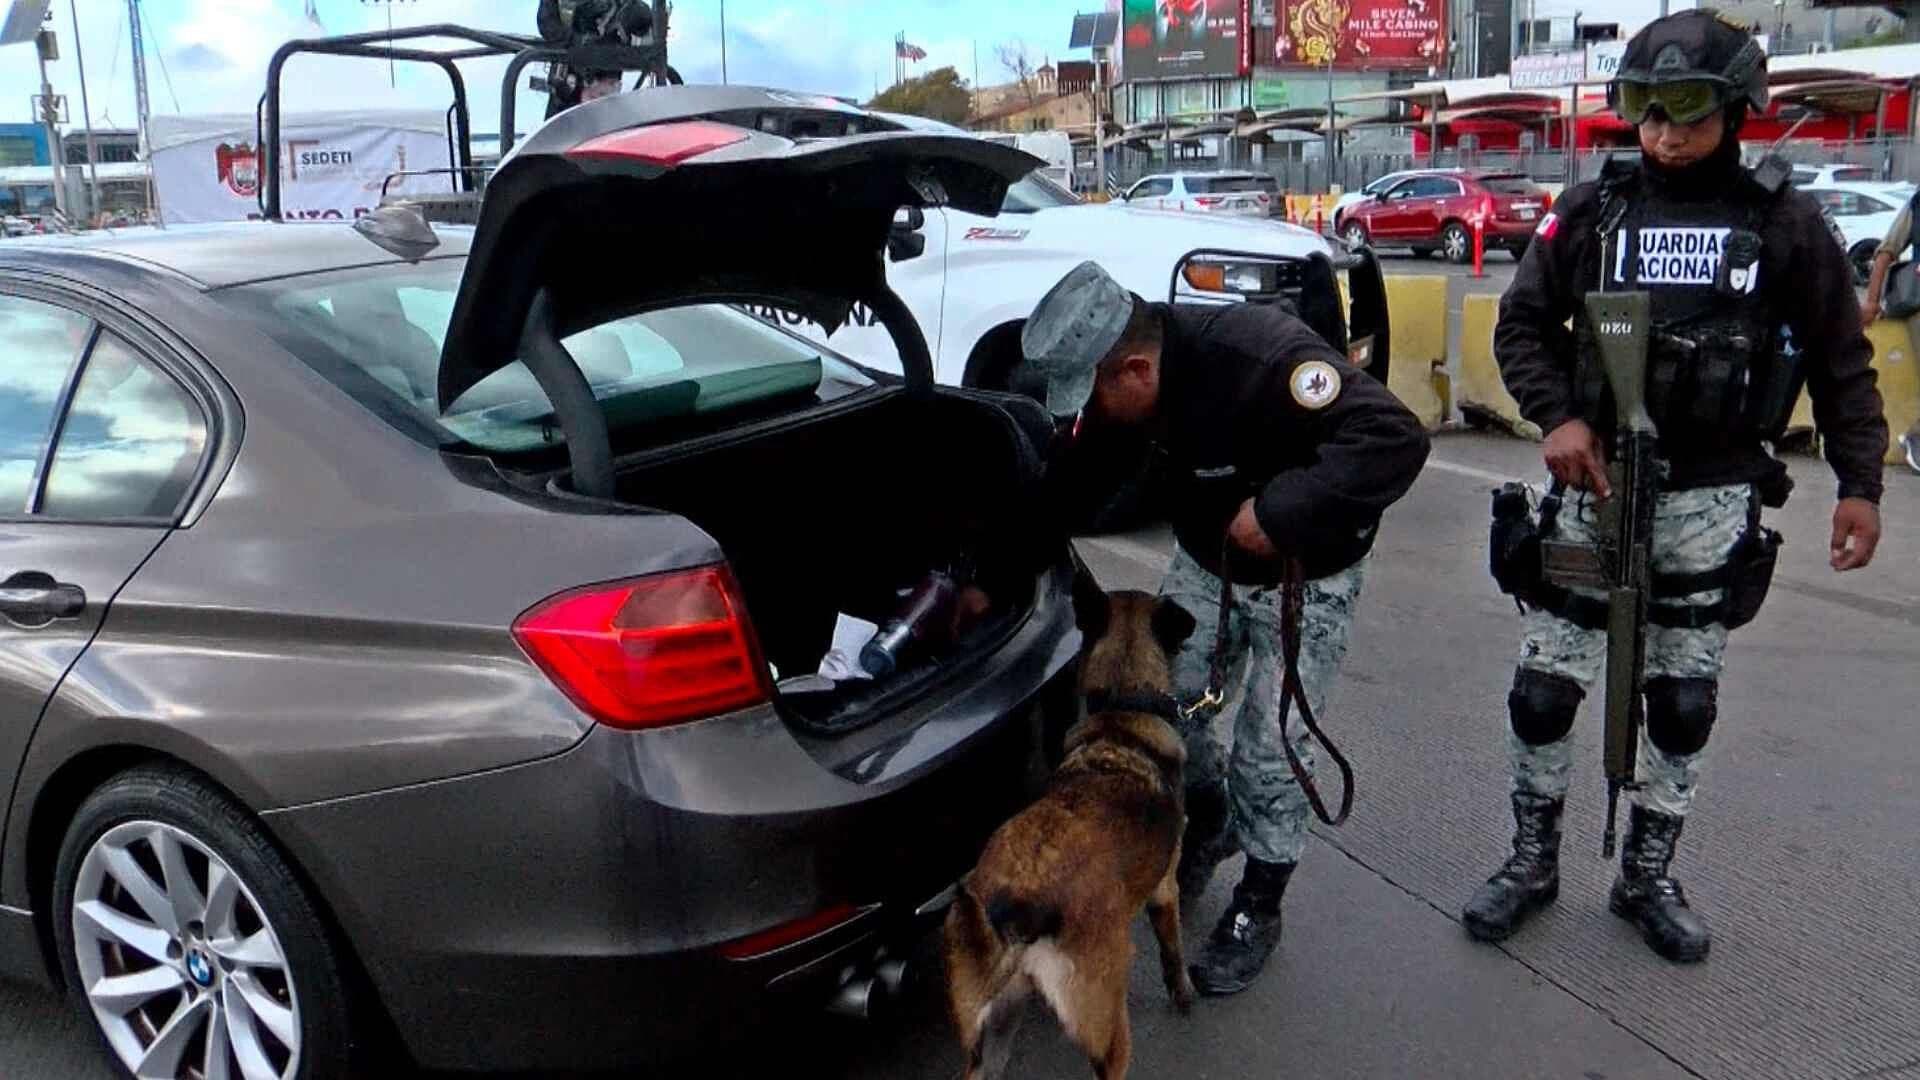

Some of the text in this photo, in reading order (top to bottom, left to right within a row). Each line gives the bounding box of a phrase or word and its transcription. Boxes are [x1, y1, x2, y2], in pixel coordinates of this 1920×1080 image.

[1371, 7, 1416, 19] SEVEN
[1348, 19, 1439, 30] MILE CASINO
[301, 151, 352, 165] SEDETI
[1627, 232, 1718, 254] UARDIA
[1621, 256, 1718, 280] ACIONA
